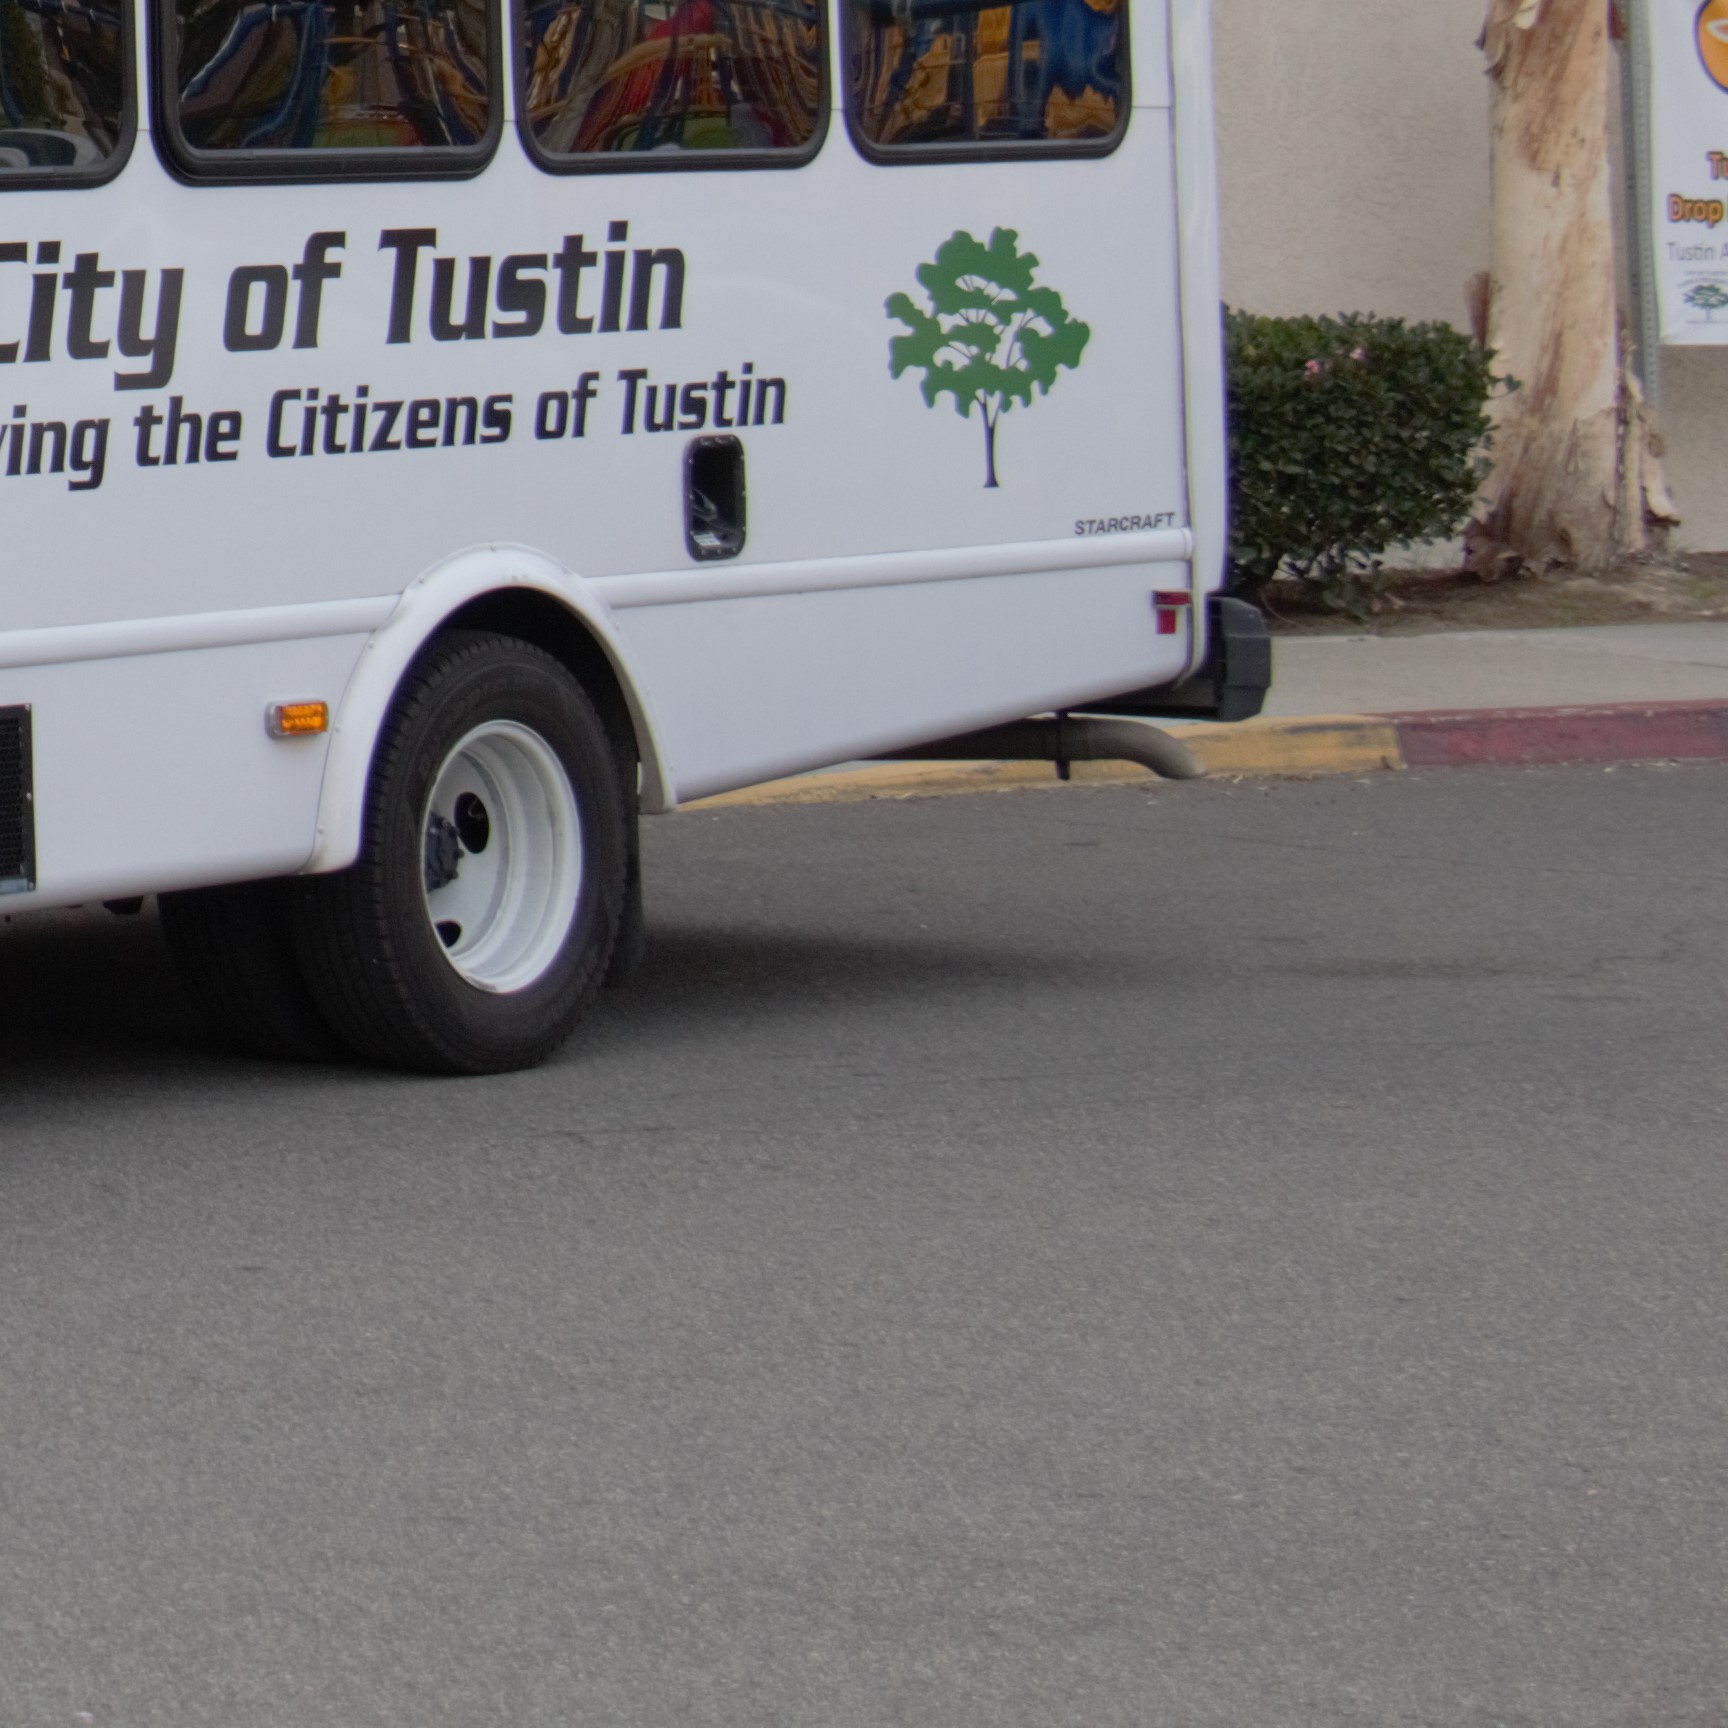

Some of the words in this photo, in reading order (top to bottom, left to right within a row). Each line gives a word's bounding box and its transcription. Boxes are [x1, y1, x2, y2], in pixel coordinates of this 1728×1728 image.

[1668, 193, 1724, 229] Drop
[1667, 243, 1715, 261] Tustin
[223, 231, 345, 352] of
[378, 220, 687, 345] Tustin
[135, 397, 242, 467] the
[267, 385, 513, 458] Citizens
[534, 372, 599, 441] of
[617, 363, 787, 437] Tustin
[1074, 512, 1175, 536] STARCRAFT
